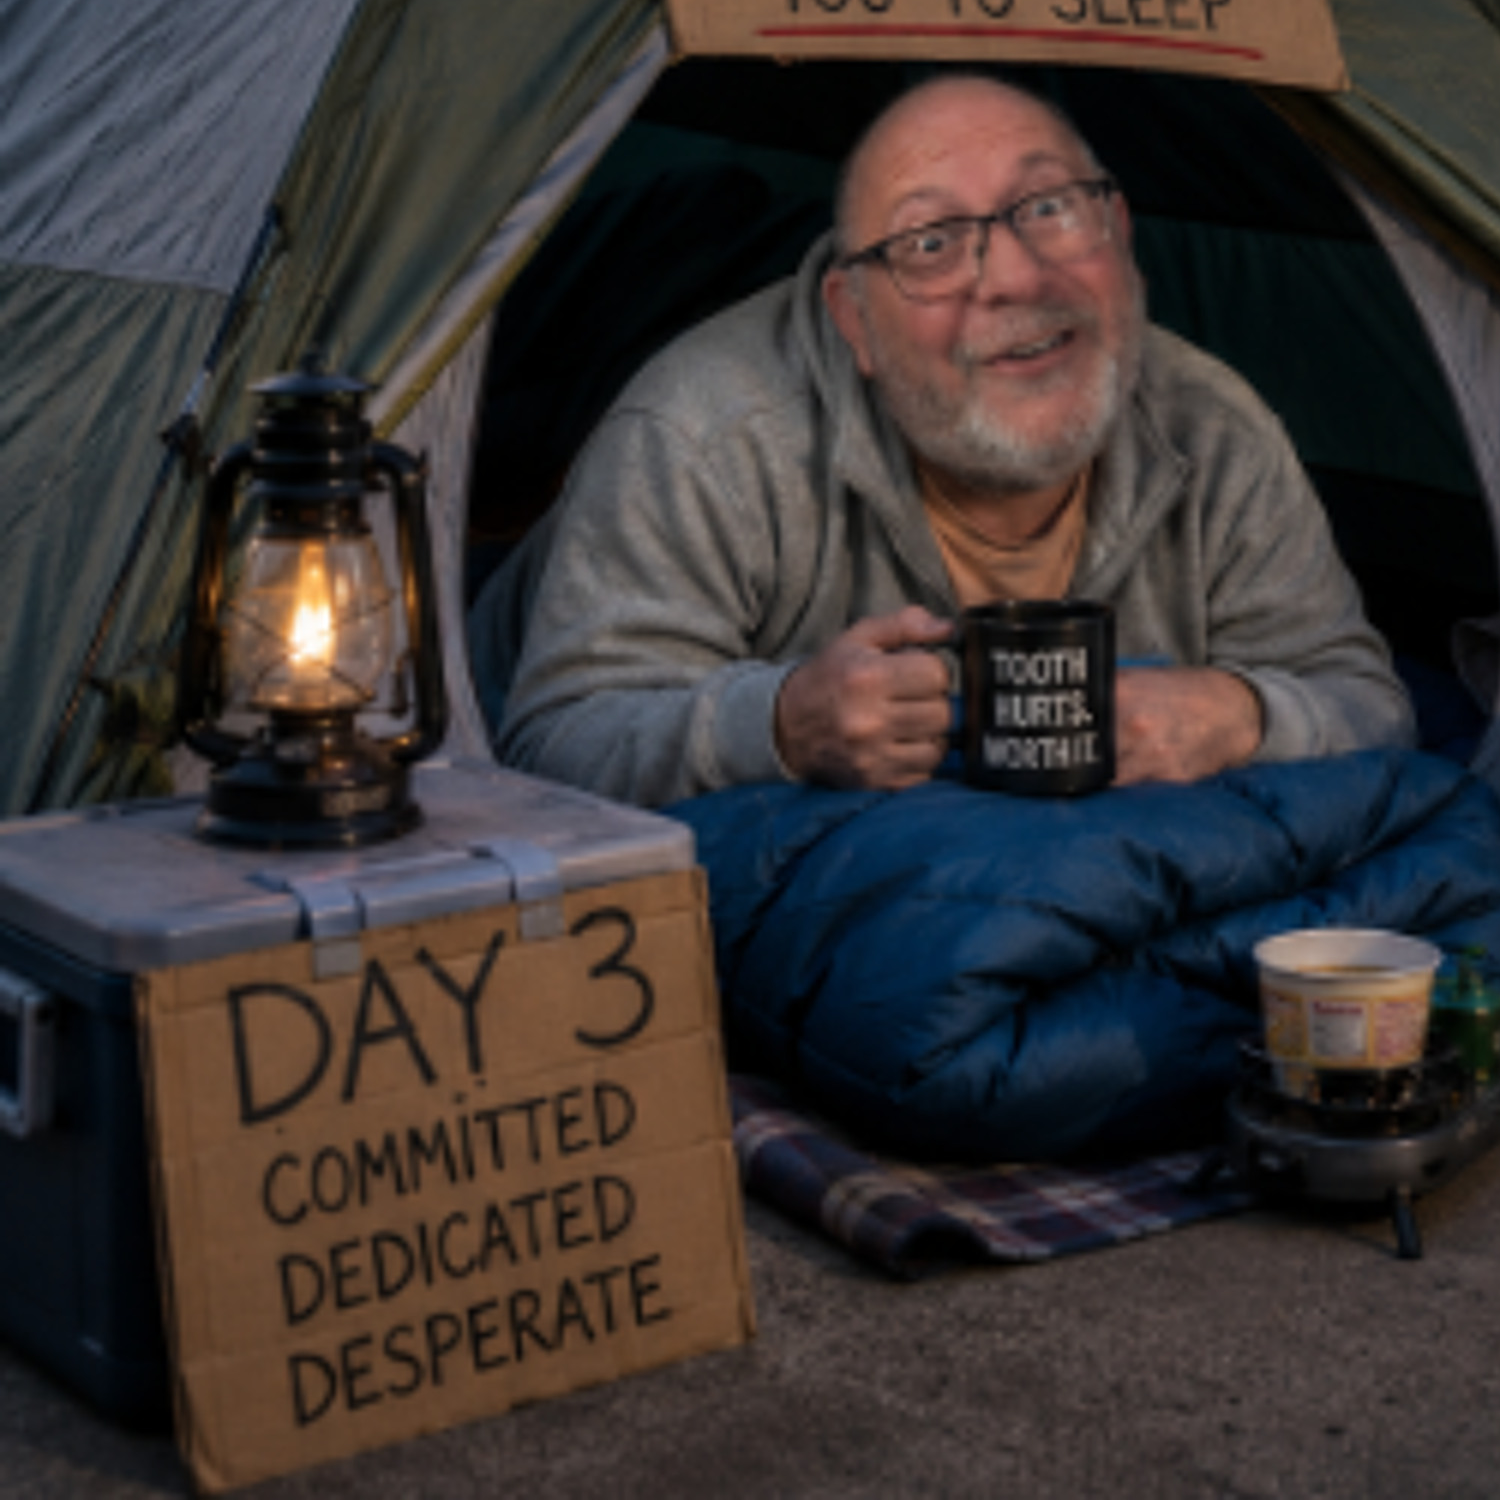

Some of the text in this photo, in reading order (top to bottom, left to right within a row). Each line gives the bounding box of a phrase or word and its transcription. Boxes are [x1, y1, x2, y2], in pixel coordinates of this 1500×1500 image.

[990, 647, 1088, 686] TOOTH
[228, 906, 656, 1127] DAY 3
[262, 1082, 636, 1227] COMMITTED
[278, 1175, 636, 1327] DEDICATED
[288, 1253, 672, 1427] DESPERATE
